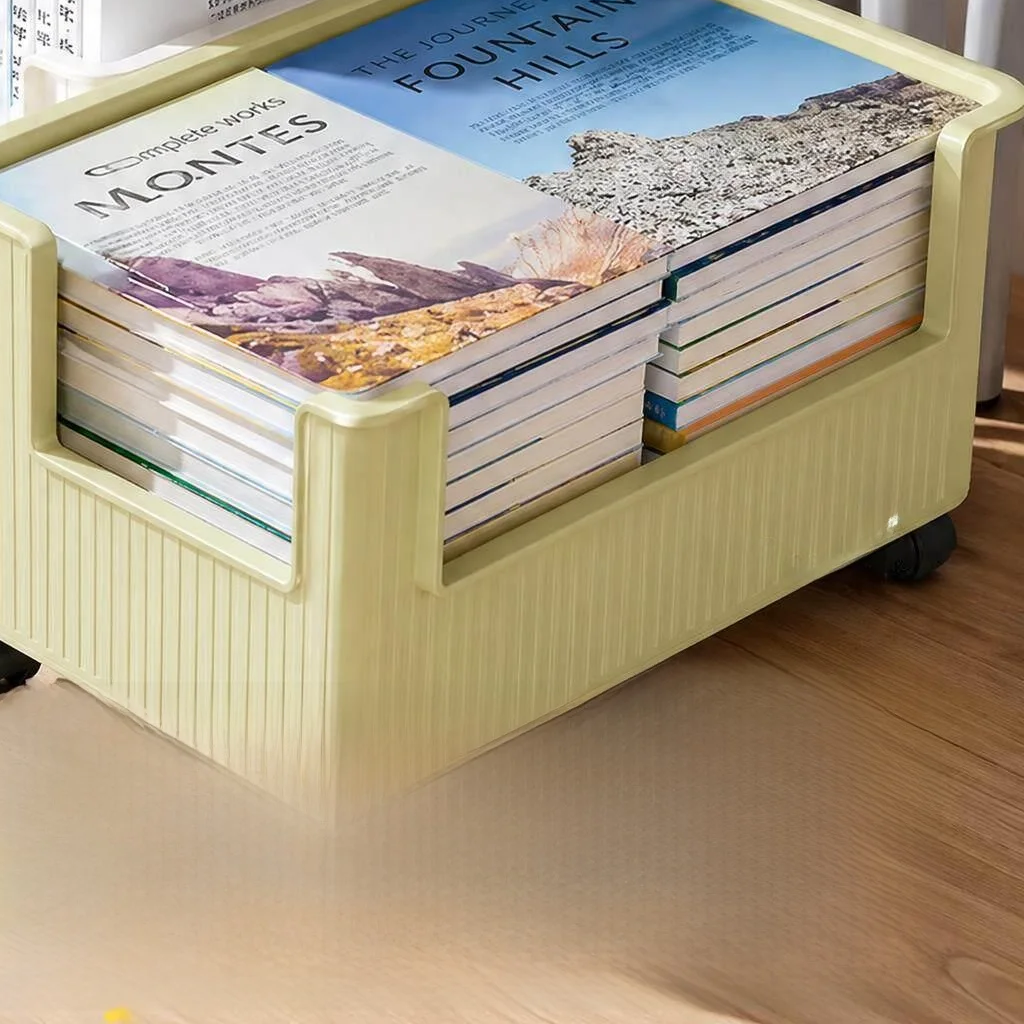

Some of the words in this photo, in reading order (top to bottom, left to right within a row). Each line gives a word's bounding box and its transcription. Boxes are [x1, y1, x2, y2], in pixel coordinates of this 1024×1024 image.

[350, 47, 417, 76] THE
[493, 31, 630, 90] HILLS
[215, 96, 286, 127] works
